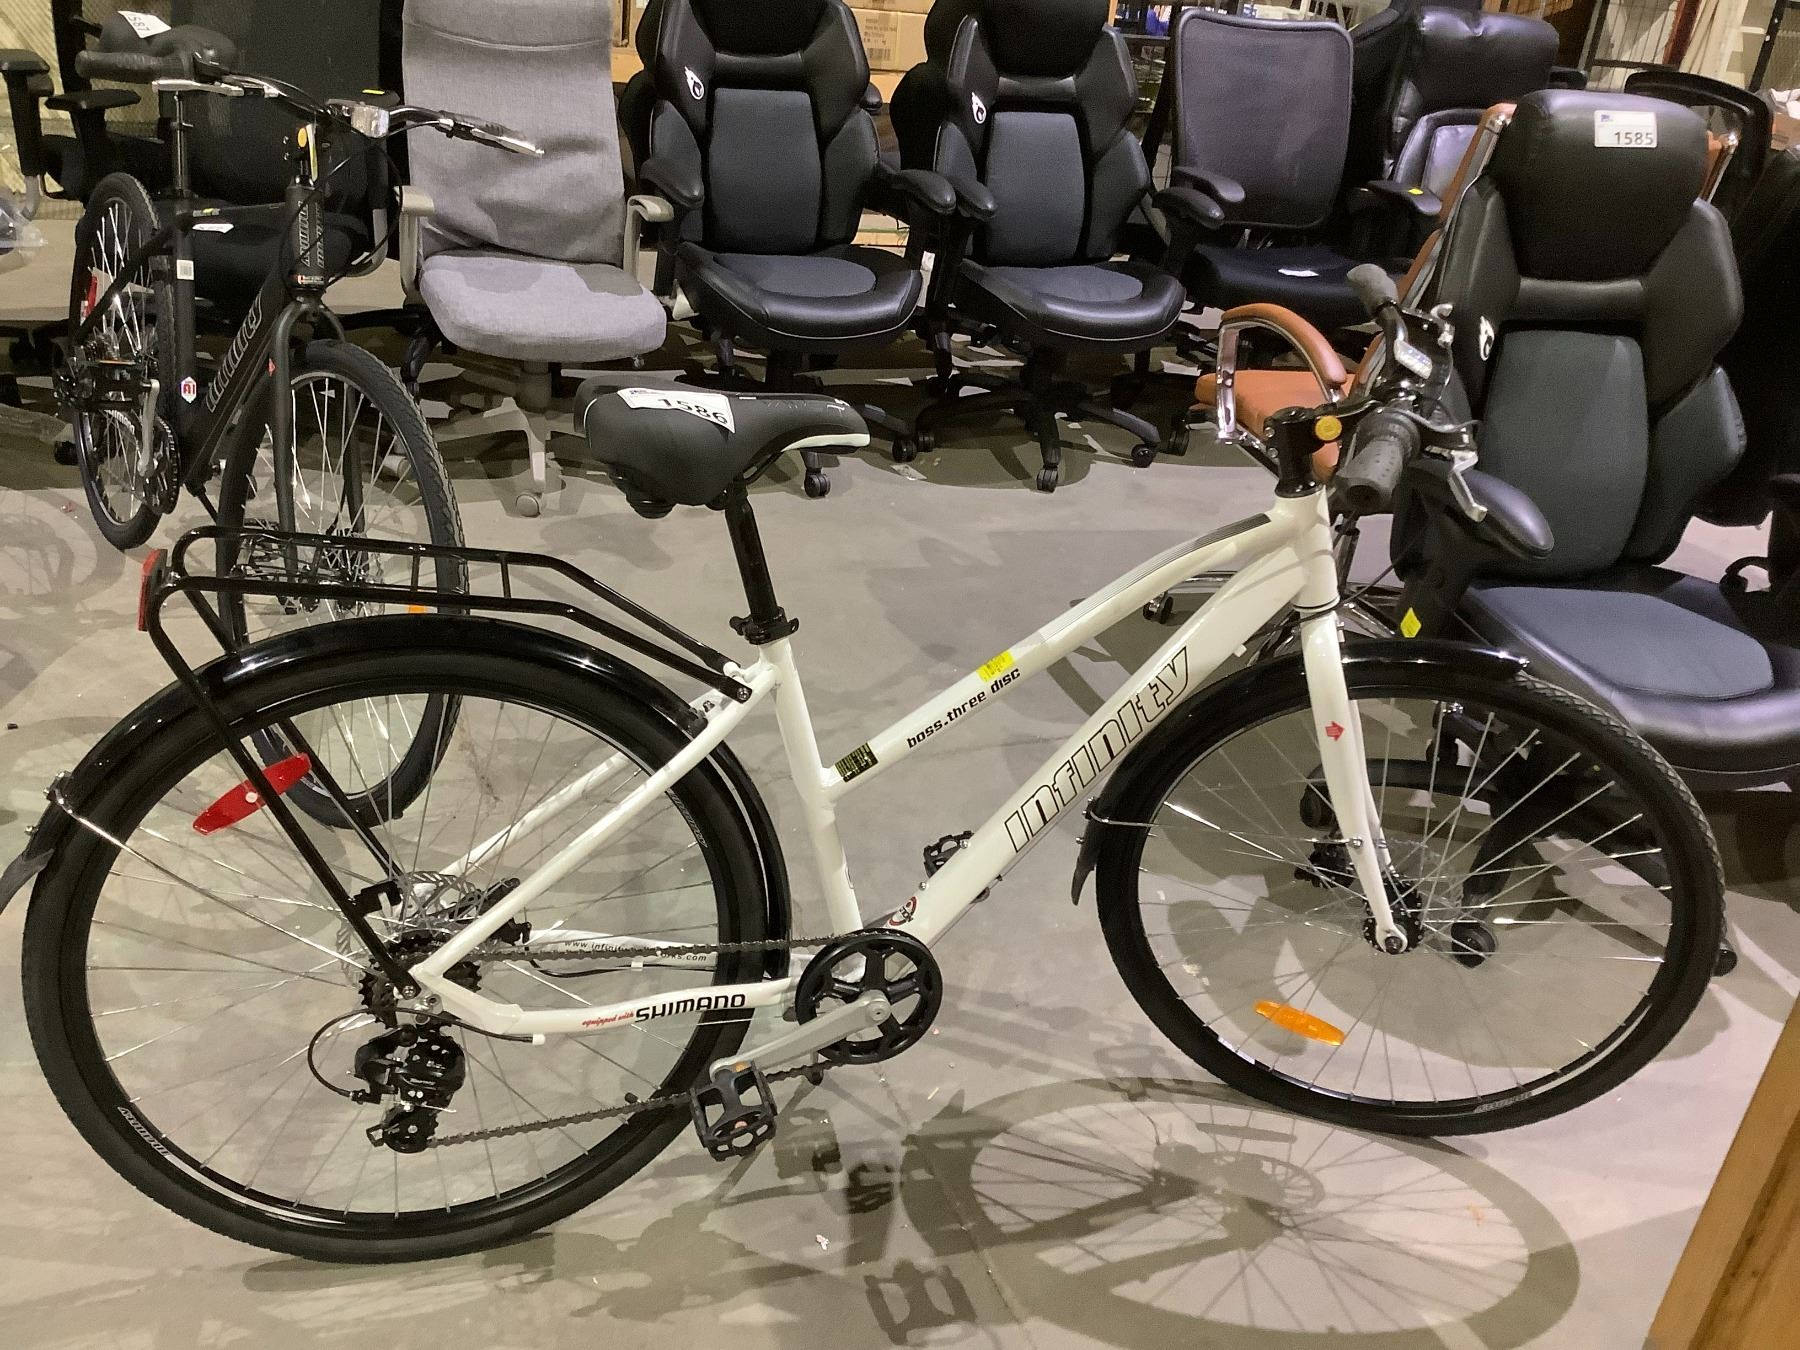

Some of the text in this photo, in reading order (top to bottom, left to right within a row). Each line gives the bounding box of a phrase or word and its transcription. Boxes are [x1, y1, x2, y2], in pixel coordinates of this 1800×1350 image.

[1614, 131, 1654, 146] 1585
[658, 398, 728, 424] 1586
[906, 668, 1021, 749] boss.three disc
[635, 993, 746, 1023] SHIMANO
